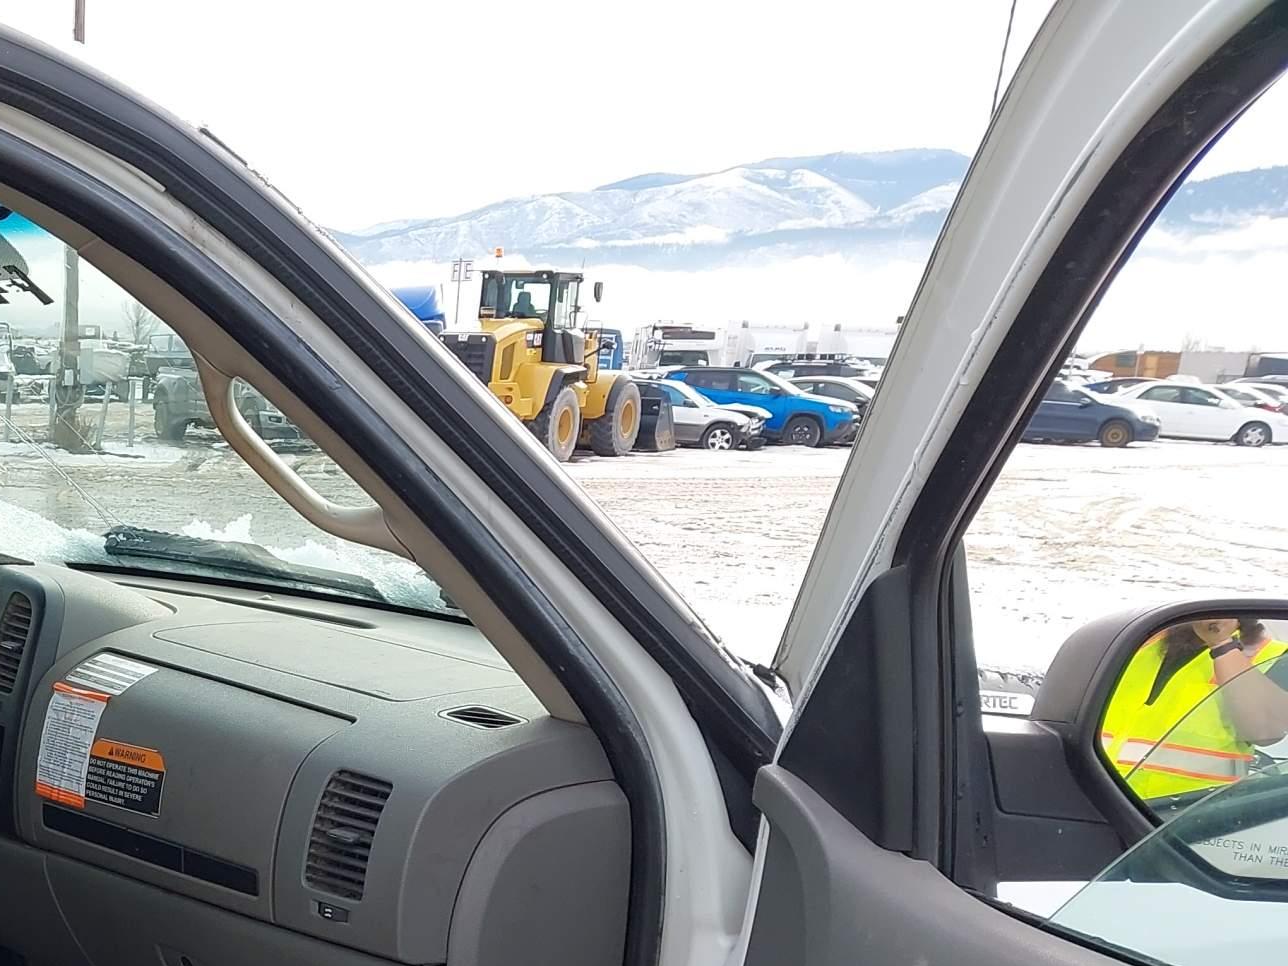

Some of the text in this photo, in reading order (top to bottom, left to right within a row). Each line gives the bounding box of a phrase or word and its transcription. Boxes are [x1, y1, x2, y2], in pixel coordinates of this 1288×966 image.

[114, 747, 146, 763] WARNING
[89, 766, 106, 775] BEFORE
[106, 770, 125, 780] READING
[106, 761, 126, 773] OPERATE
[138, 768, 160, 780] MACHINE
[107, 778, 125, 788] FAILURE
[86, 789, 108, 801] PERSONAL
[87, 782, 101, 791] COULD
[101, 785, 118, 795] RESULT
[124, 792, 143, 801] SEVERE
[1250, 843, 1261, 852] IN
[1269, 846, 1288, 856] MIR
[1233, 852, 1263, 864] THAN
